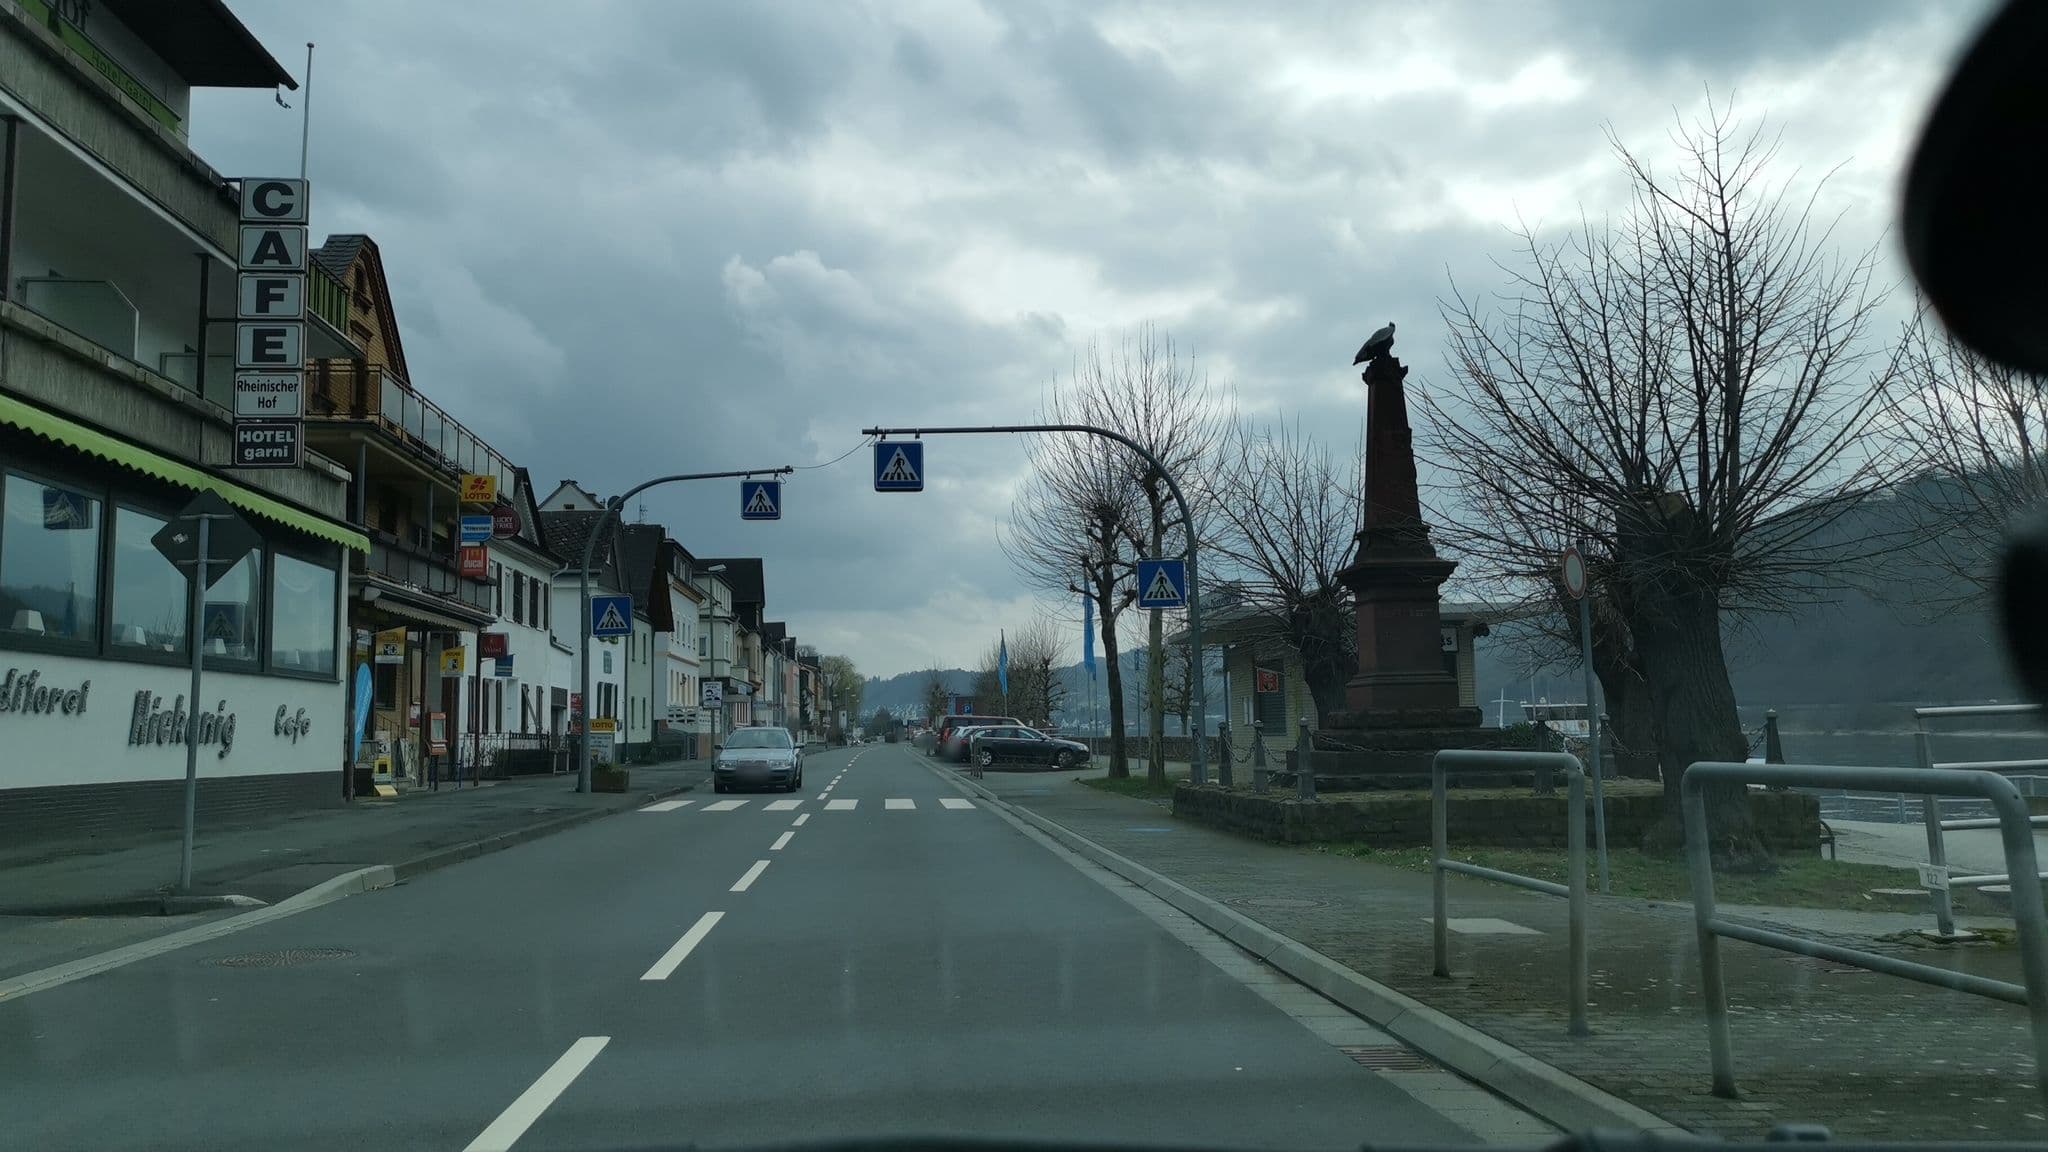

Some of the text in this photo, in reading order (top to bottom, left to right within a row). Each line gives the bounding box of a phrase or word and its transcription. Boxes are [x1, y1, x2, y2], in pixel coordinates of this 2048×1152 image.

[250, 181, 295, 363] CAFE
[236, 379, 299, 393] Rheinischer
[257, 395, 278, 409] Hof
[239, 430, 295, 443] HOTEL
[243, 445, 289, 461] garni
[464, 492, 492, 501] LOTTO
[128, 690, 238, 760] Nicknig
